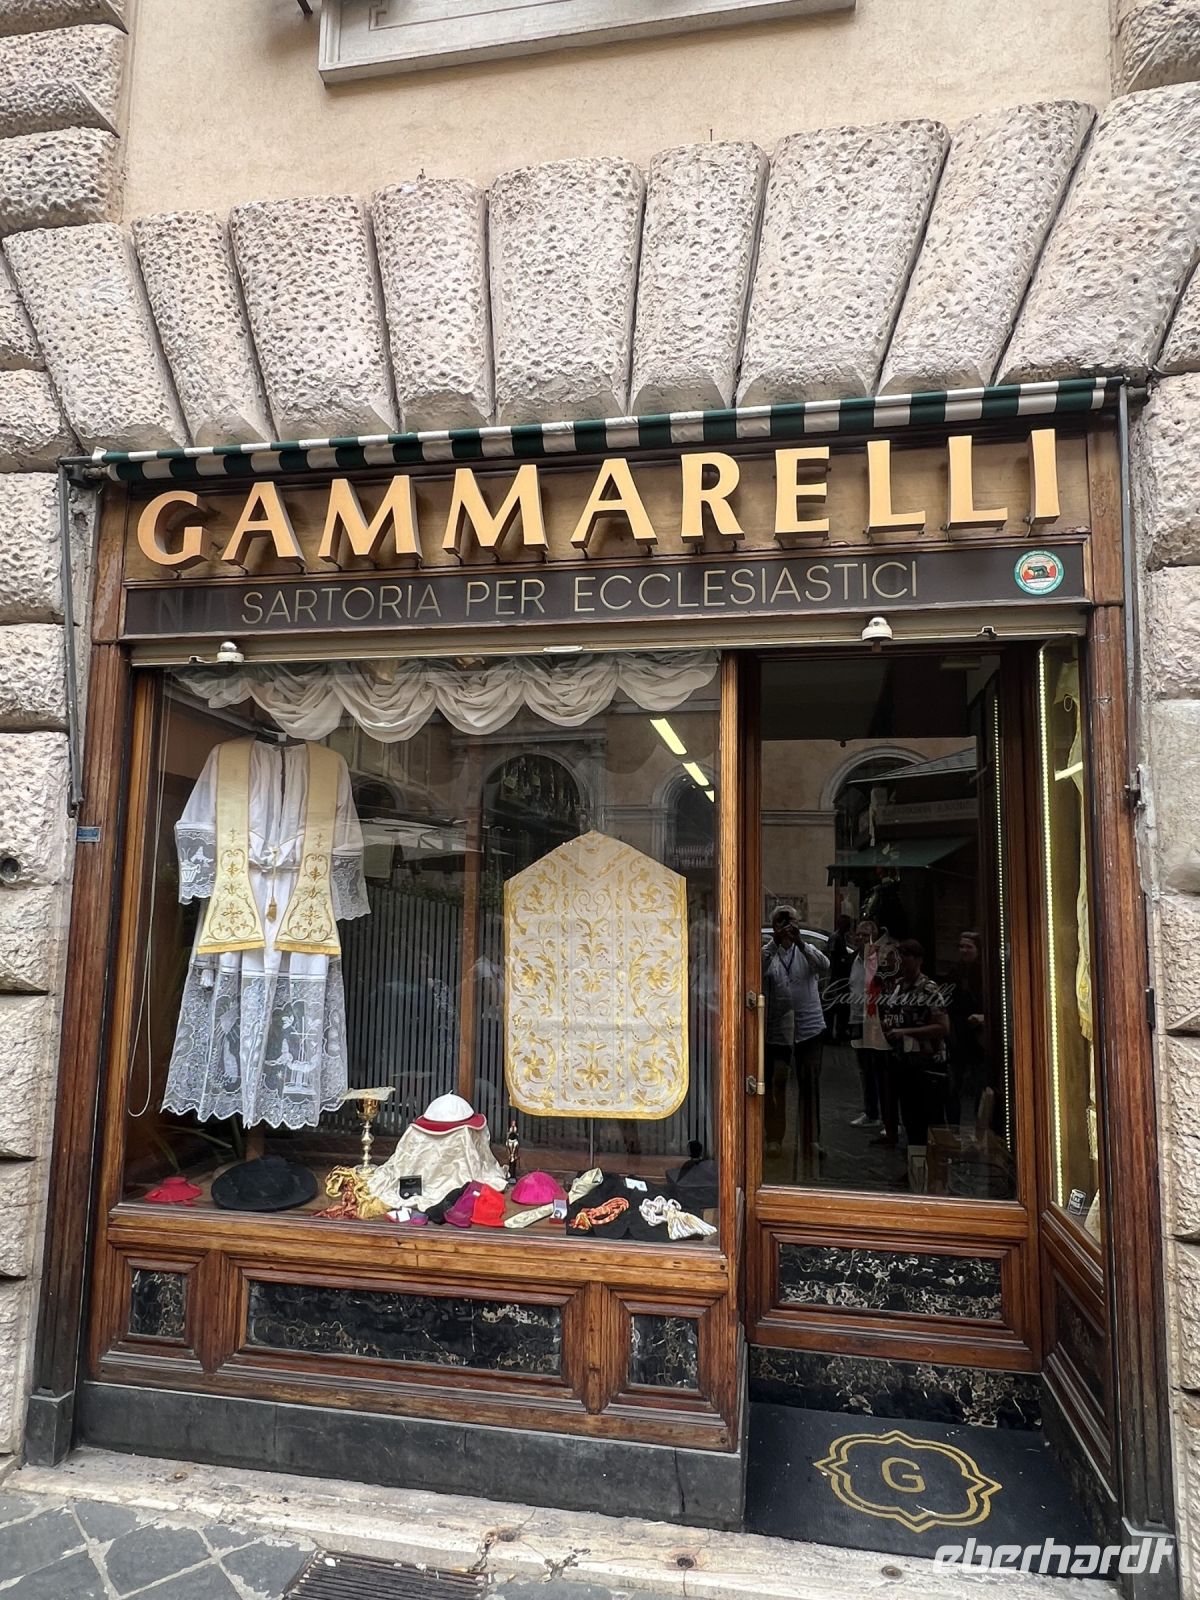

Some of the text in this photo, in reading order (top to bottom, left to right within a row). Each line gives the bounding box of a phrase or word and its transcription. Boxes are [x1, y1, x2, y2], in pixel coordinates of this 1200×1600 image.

[136, 428, 1061, 569] GAMMARELLI
[241, 583, 442, 625] SARTORIA
[465, 578, 546, 617] PER
[573, 560, 917, 613] ECCLESIASTICI
[880, 1456, 926, 1494] G
